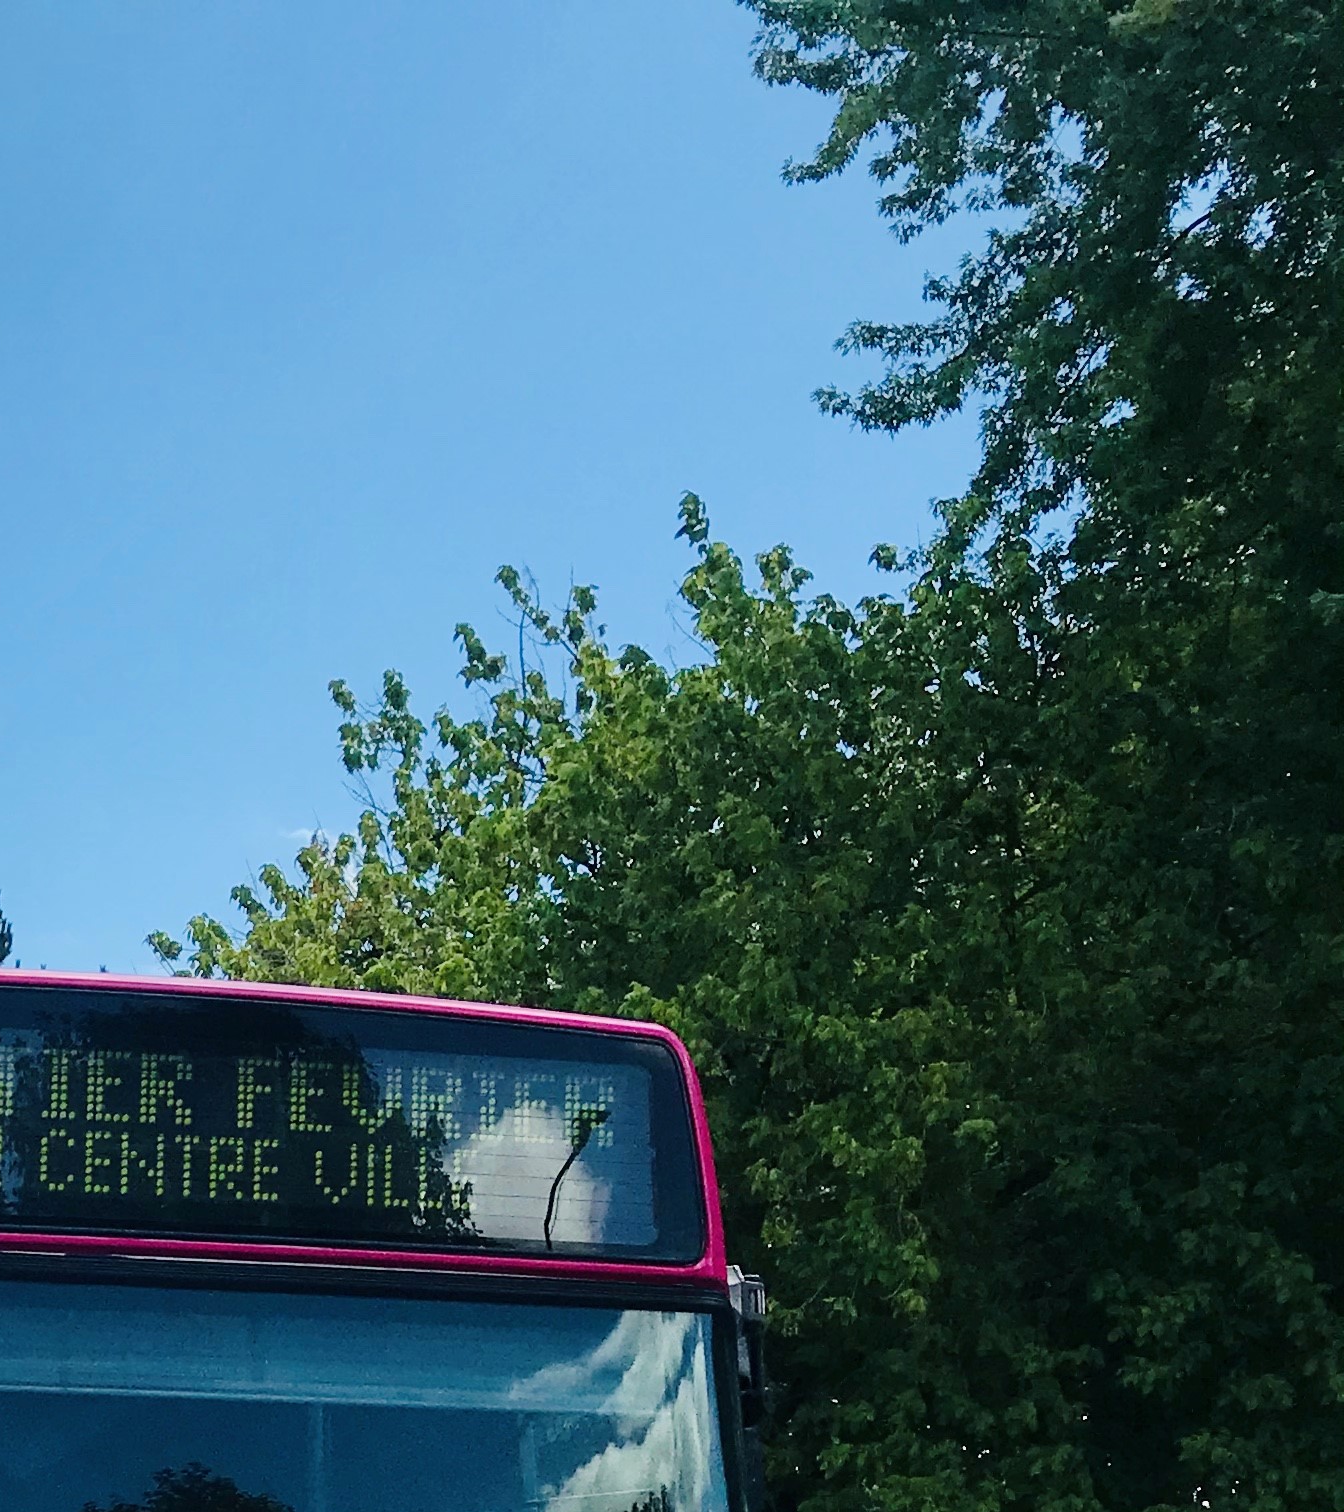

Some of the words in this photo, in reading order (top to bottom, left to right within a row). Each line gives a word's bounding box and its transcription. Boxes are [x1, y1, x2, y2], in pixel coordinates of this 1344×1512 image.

[235, 1054, 615, 1148] FEVRIER
[39, 1124, 279, 1202] CENTRE
[314, 1141, 478, 1212] VILLE
